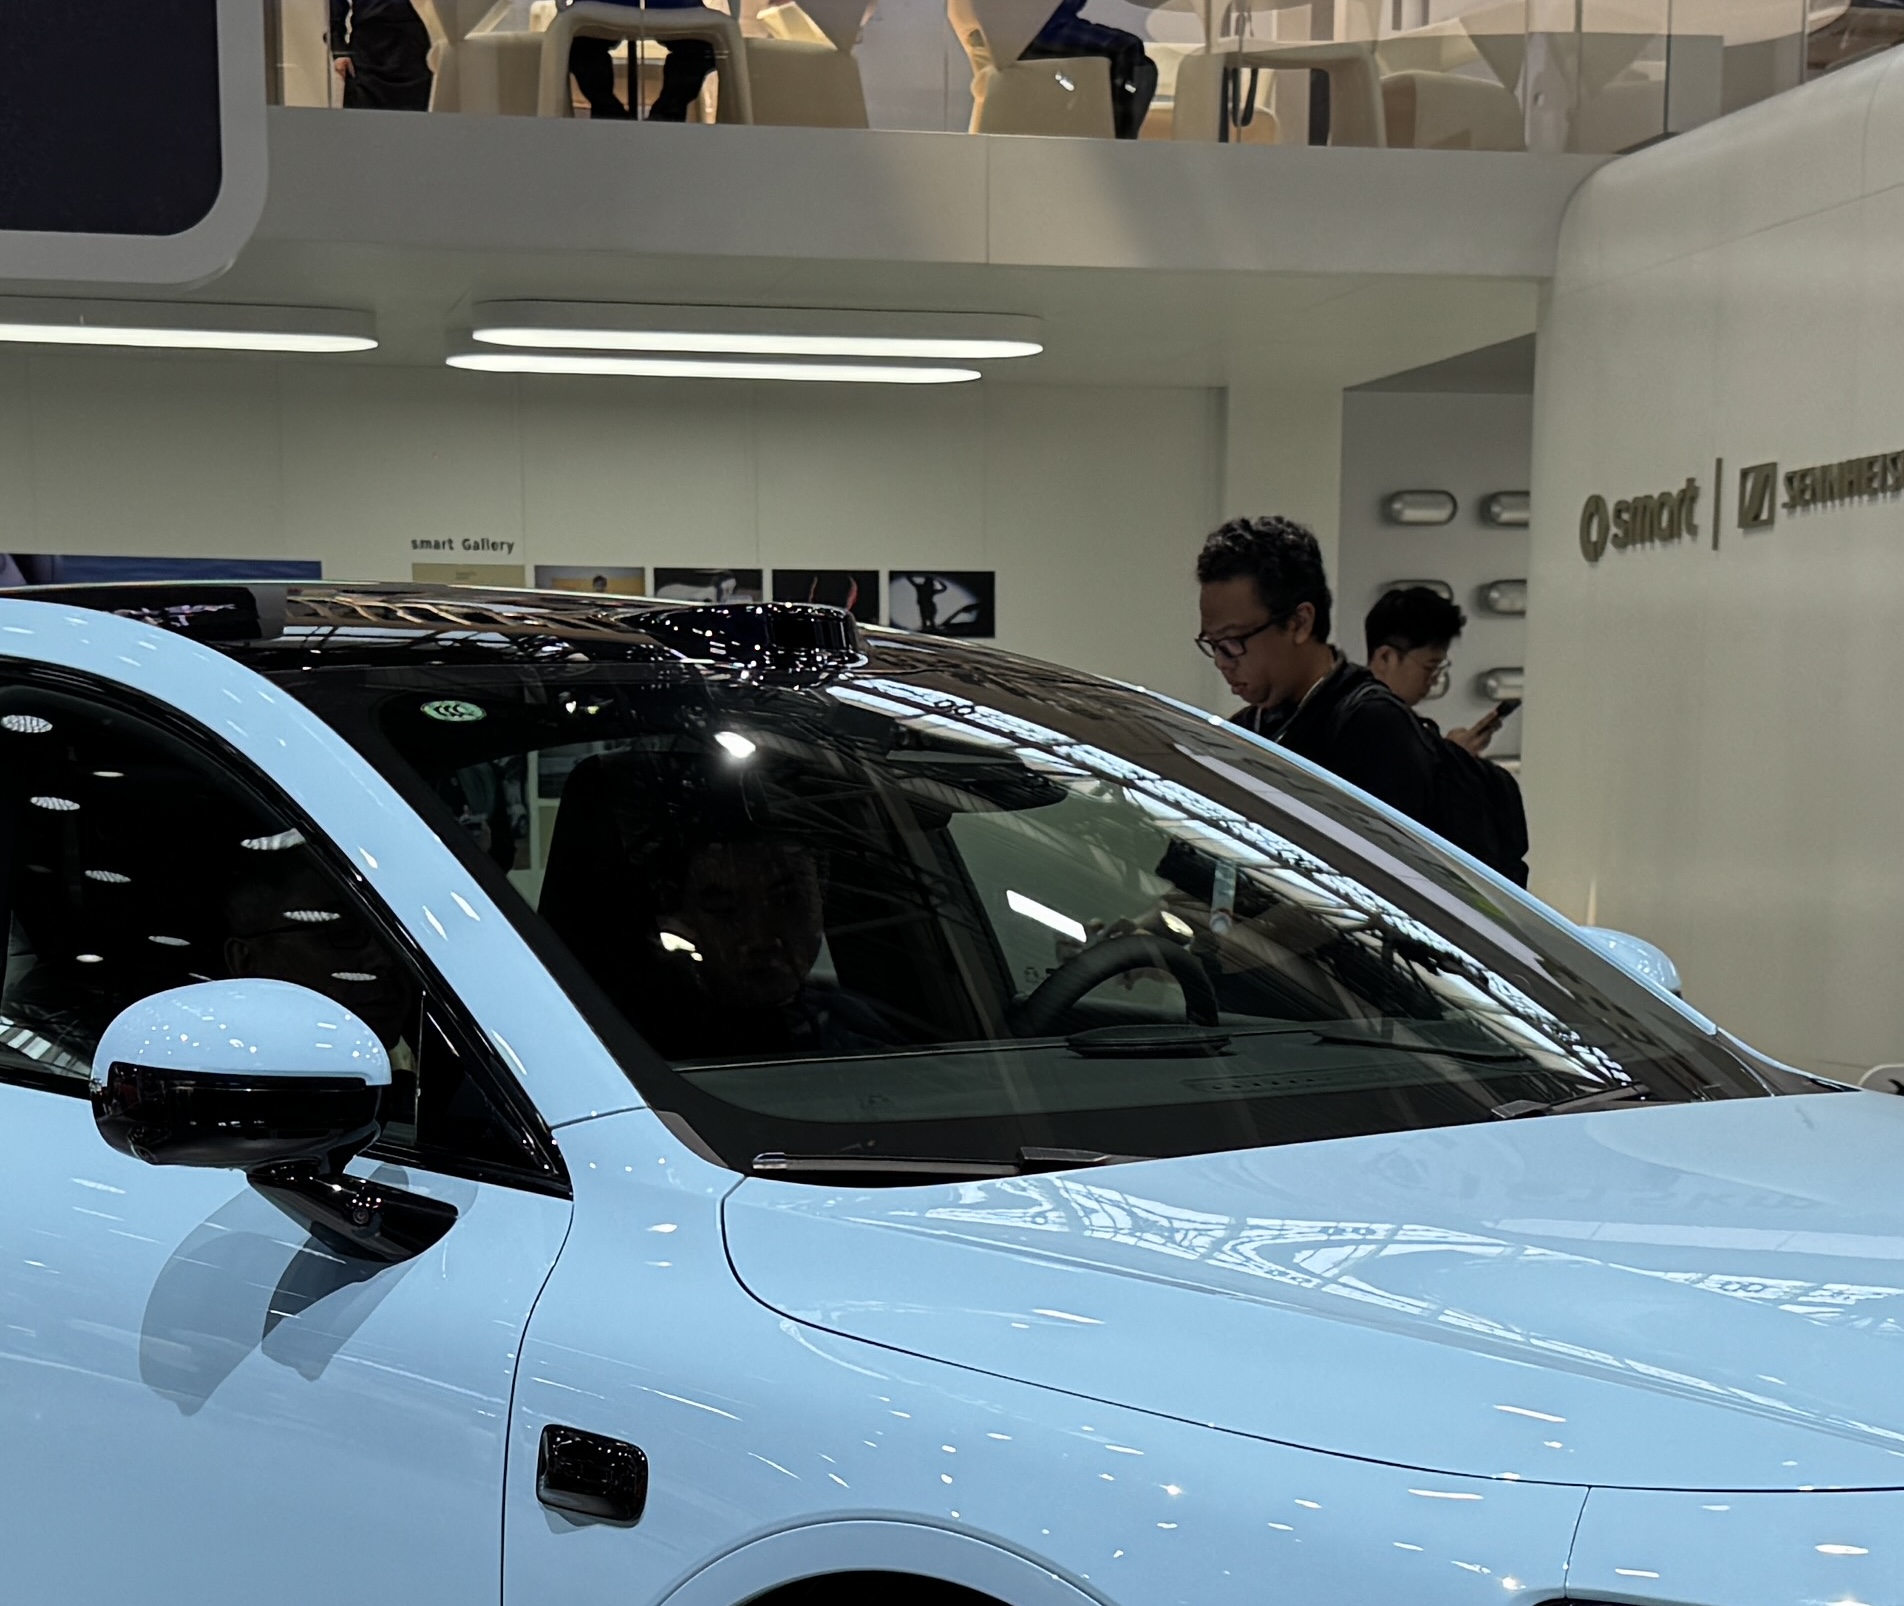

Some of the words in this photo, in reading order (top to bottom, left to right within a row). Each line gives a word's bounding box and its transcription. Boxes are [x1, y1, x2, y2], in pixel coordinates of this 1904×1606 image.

[1610, 478, 1699, 550] smart
[411, 538, 455, 552] smart
[462, 538, 516, 555] Gallery
